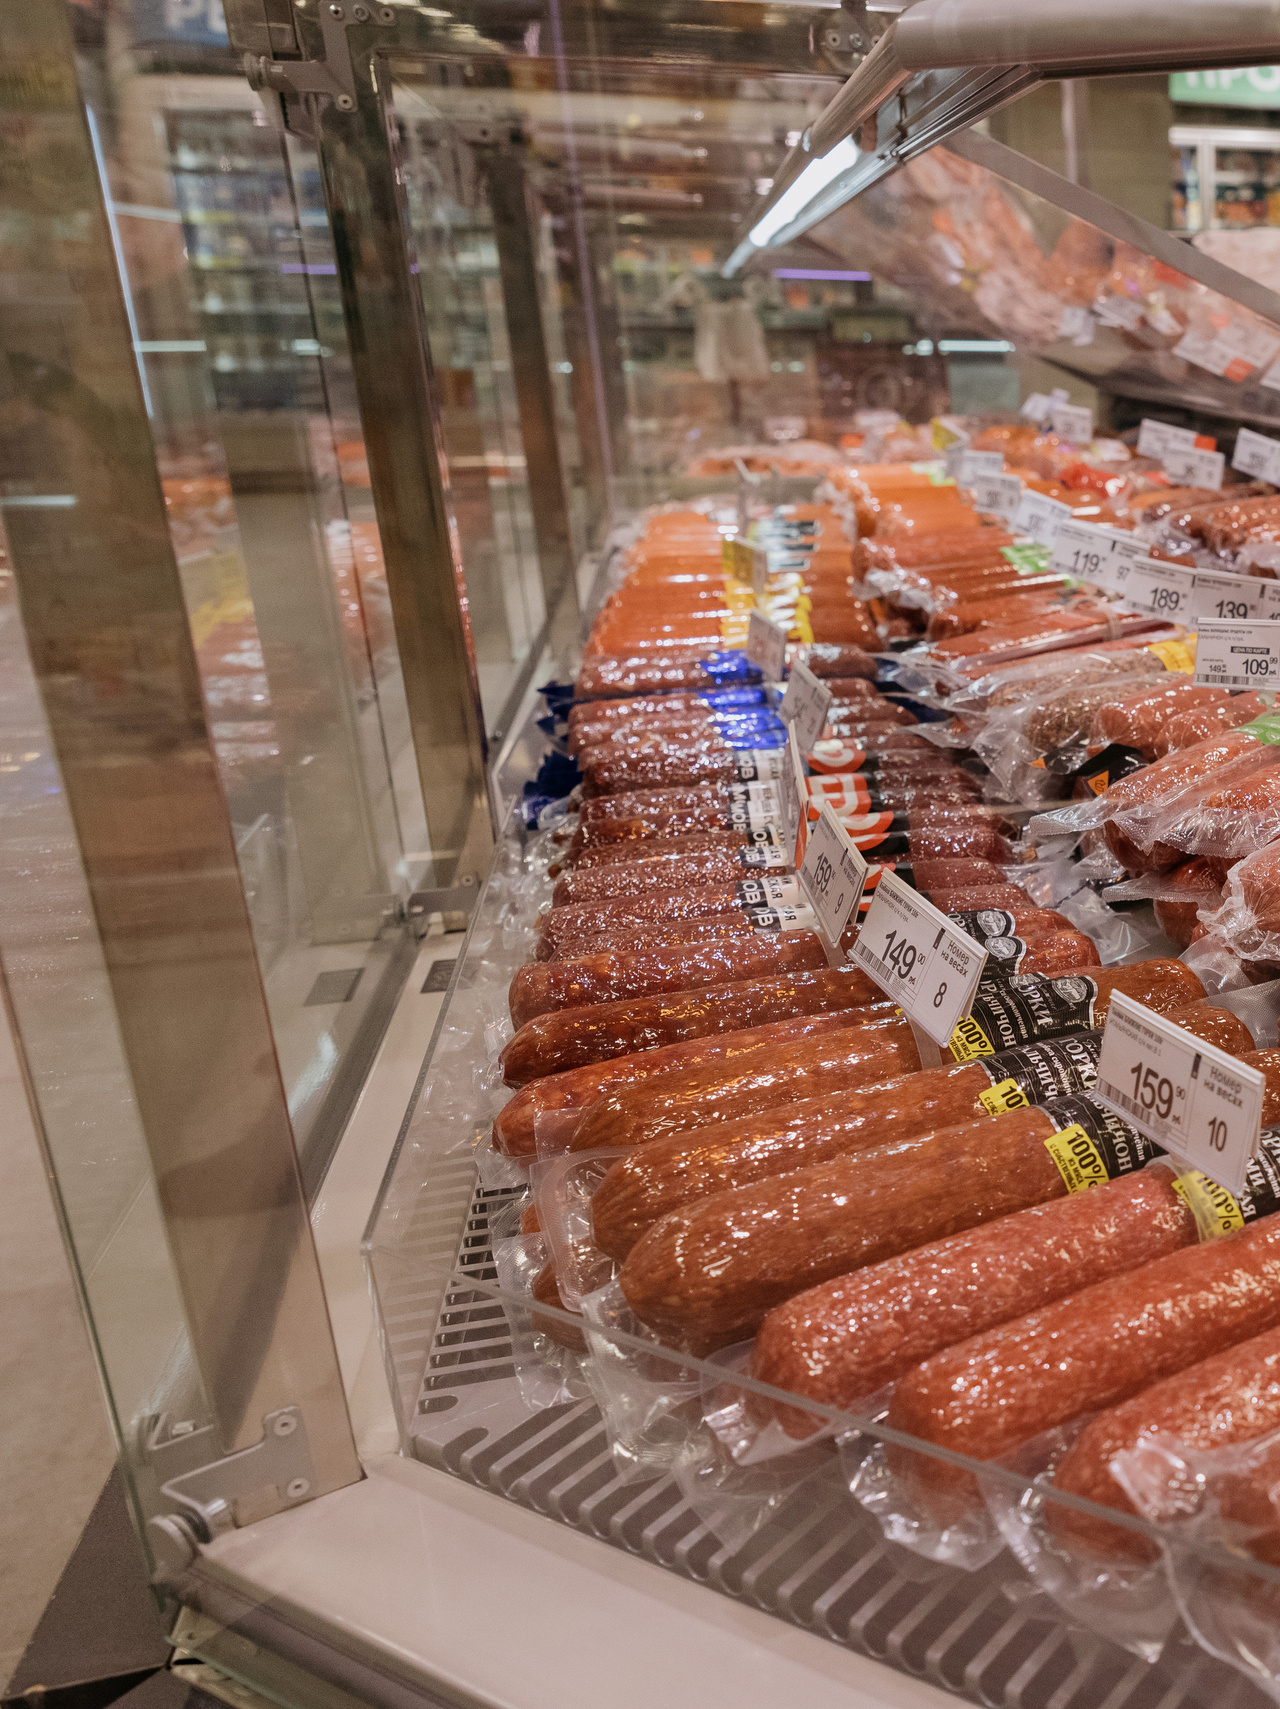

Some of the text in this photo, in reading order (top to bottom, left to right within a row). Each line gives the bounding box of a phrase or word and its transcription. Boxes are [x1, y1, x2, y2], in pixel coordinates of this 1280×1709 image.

[1072, 550, 1099, 574] 119
[1150, 587, 1180, 611] 189
[1215, 600, 1248, 619] 139
[1209, 664, 1222, 673] 149
[1242, 658, 1269, 676] 109
[814, 852, 833, 894] 159
[834, 893, 844, 914] 9
[881, 929, 926, 980] 149 00
[940, 950, 968, 979] на весах
[948, 940, 970, 966] Номер
[933, 981, 948, 1008] 8
[1017, 984, 1053, 1025] ОРКИ
[983, 992, 1017, 1047] ЬЧИЧОН
[1131, 1061, 1186, 1120] 159 90
[1210, 1065, 1243, 1095] Номер
[1203, 1080, 1243, 1110] на весах
[1207, 1116, 1228, 1152] 10
[1067, 1131, 1106, 1189] 100%
[1072, 1166, 1085, 1185] МЯСА
